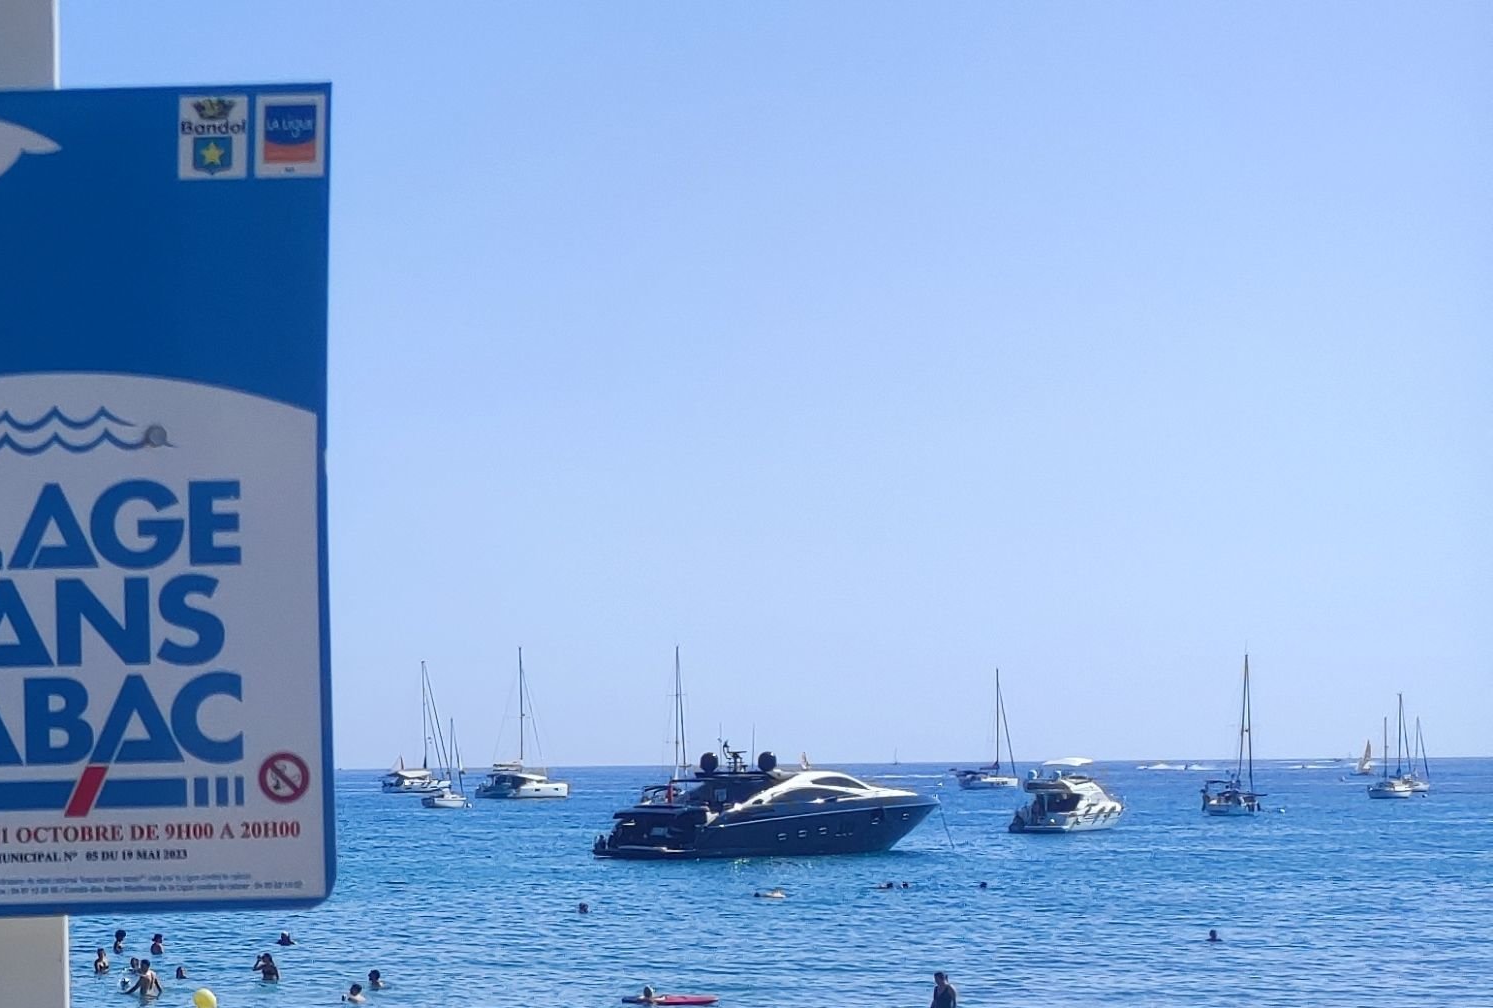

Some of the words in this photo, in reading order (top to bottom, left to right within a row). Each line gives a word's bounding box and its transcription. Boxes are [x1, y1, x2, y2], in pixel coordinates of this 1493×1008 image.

[181, 120, 246, 135] Bandol
[16, 824, 124, 844] OCTOBRE
[130, 824, 159, 841] DE
[165, 822, 214, 840] 9H00
[220, 822, 235, 839] A
[240, 821, 301, 839] 20H00
[101, 850, 118, 861] DU
[122, 849, 133, 861] 19
[136, 848, 160, 860] MAI
